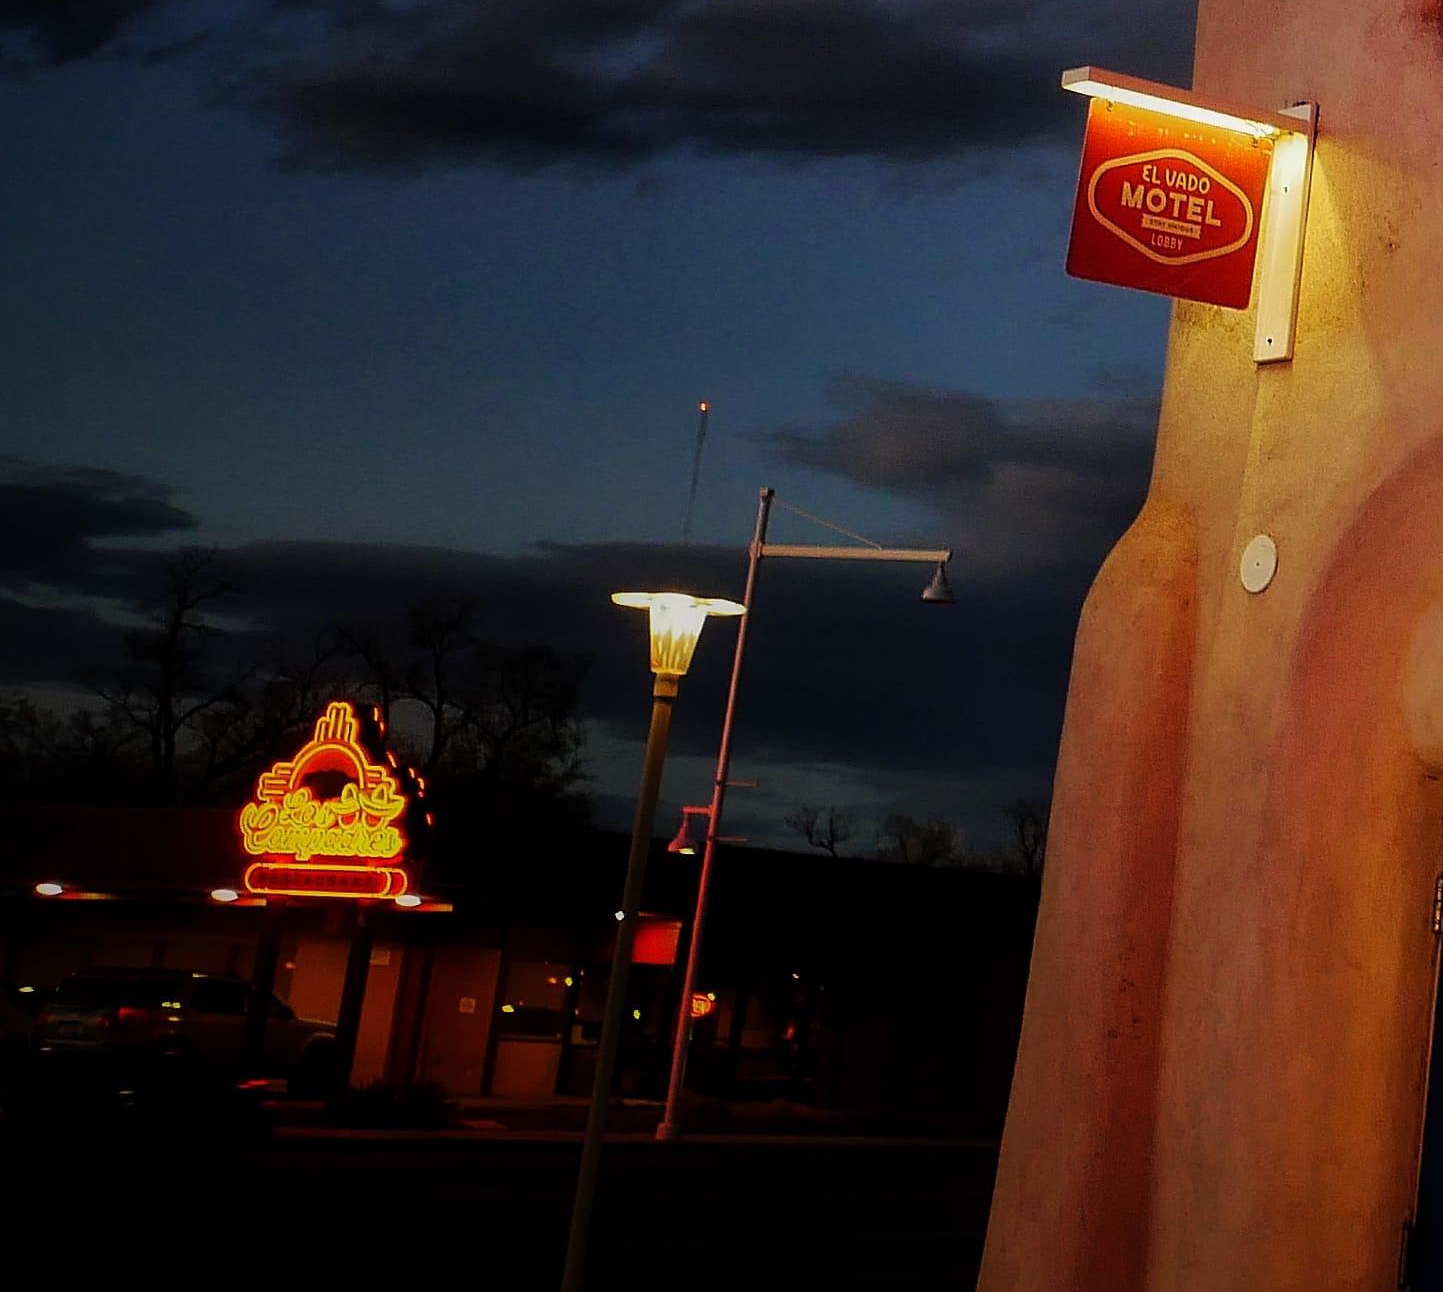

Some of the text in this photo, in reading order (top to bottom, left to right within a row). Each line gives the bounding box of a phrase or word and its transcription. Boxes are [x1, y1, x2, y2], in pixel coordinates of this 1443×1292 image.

[1142, 164, 1211, 195] EL VADO
[1121, 181, 1222, 227] MOTEL
[1151, 233, 1184, 251] LOBBY
